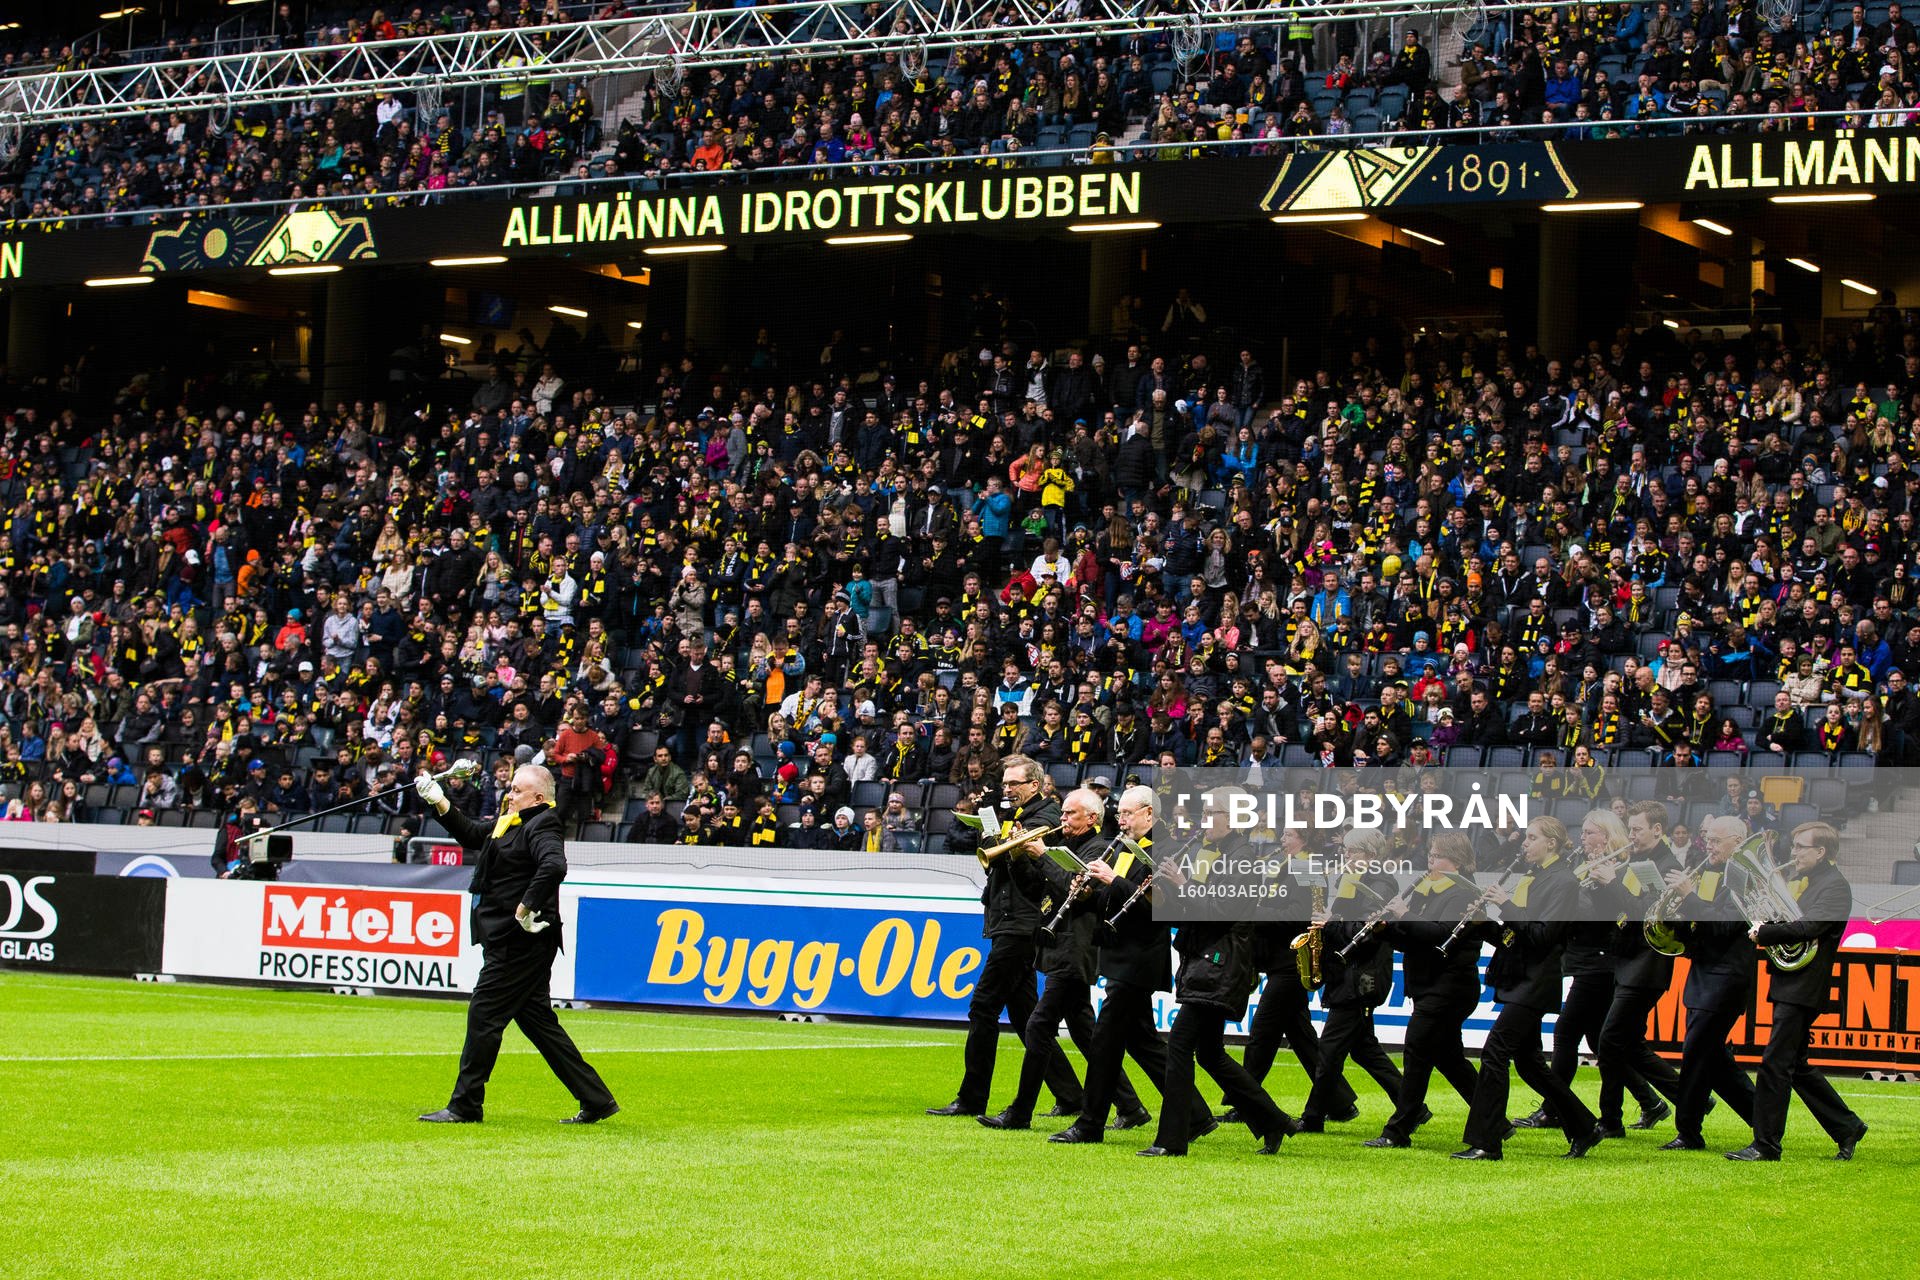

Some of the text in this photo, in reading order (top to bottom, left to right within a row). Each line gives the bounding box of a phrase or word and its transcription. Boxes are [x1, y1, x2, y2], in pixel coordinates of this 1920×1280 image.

[502, 171, 1141, 247] ALLMÄNNA IDROTTSKLUBBEN
[438, 851, 457, 866] 140
[267, 894, 455, 948] Miele
[259, 951, 458, 989] PROFESSIONAL
